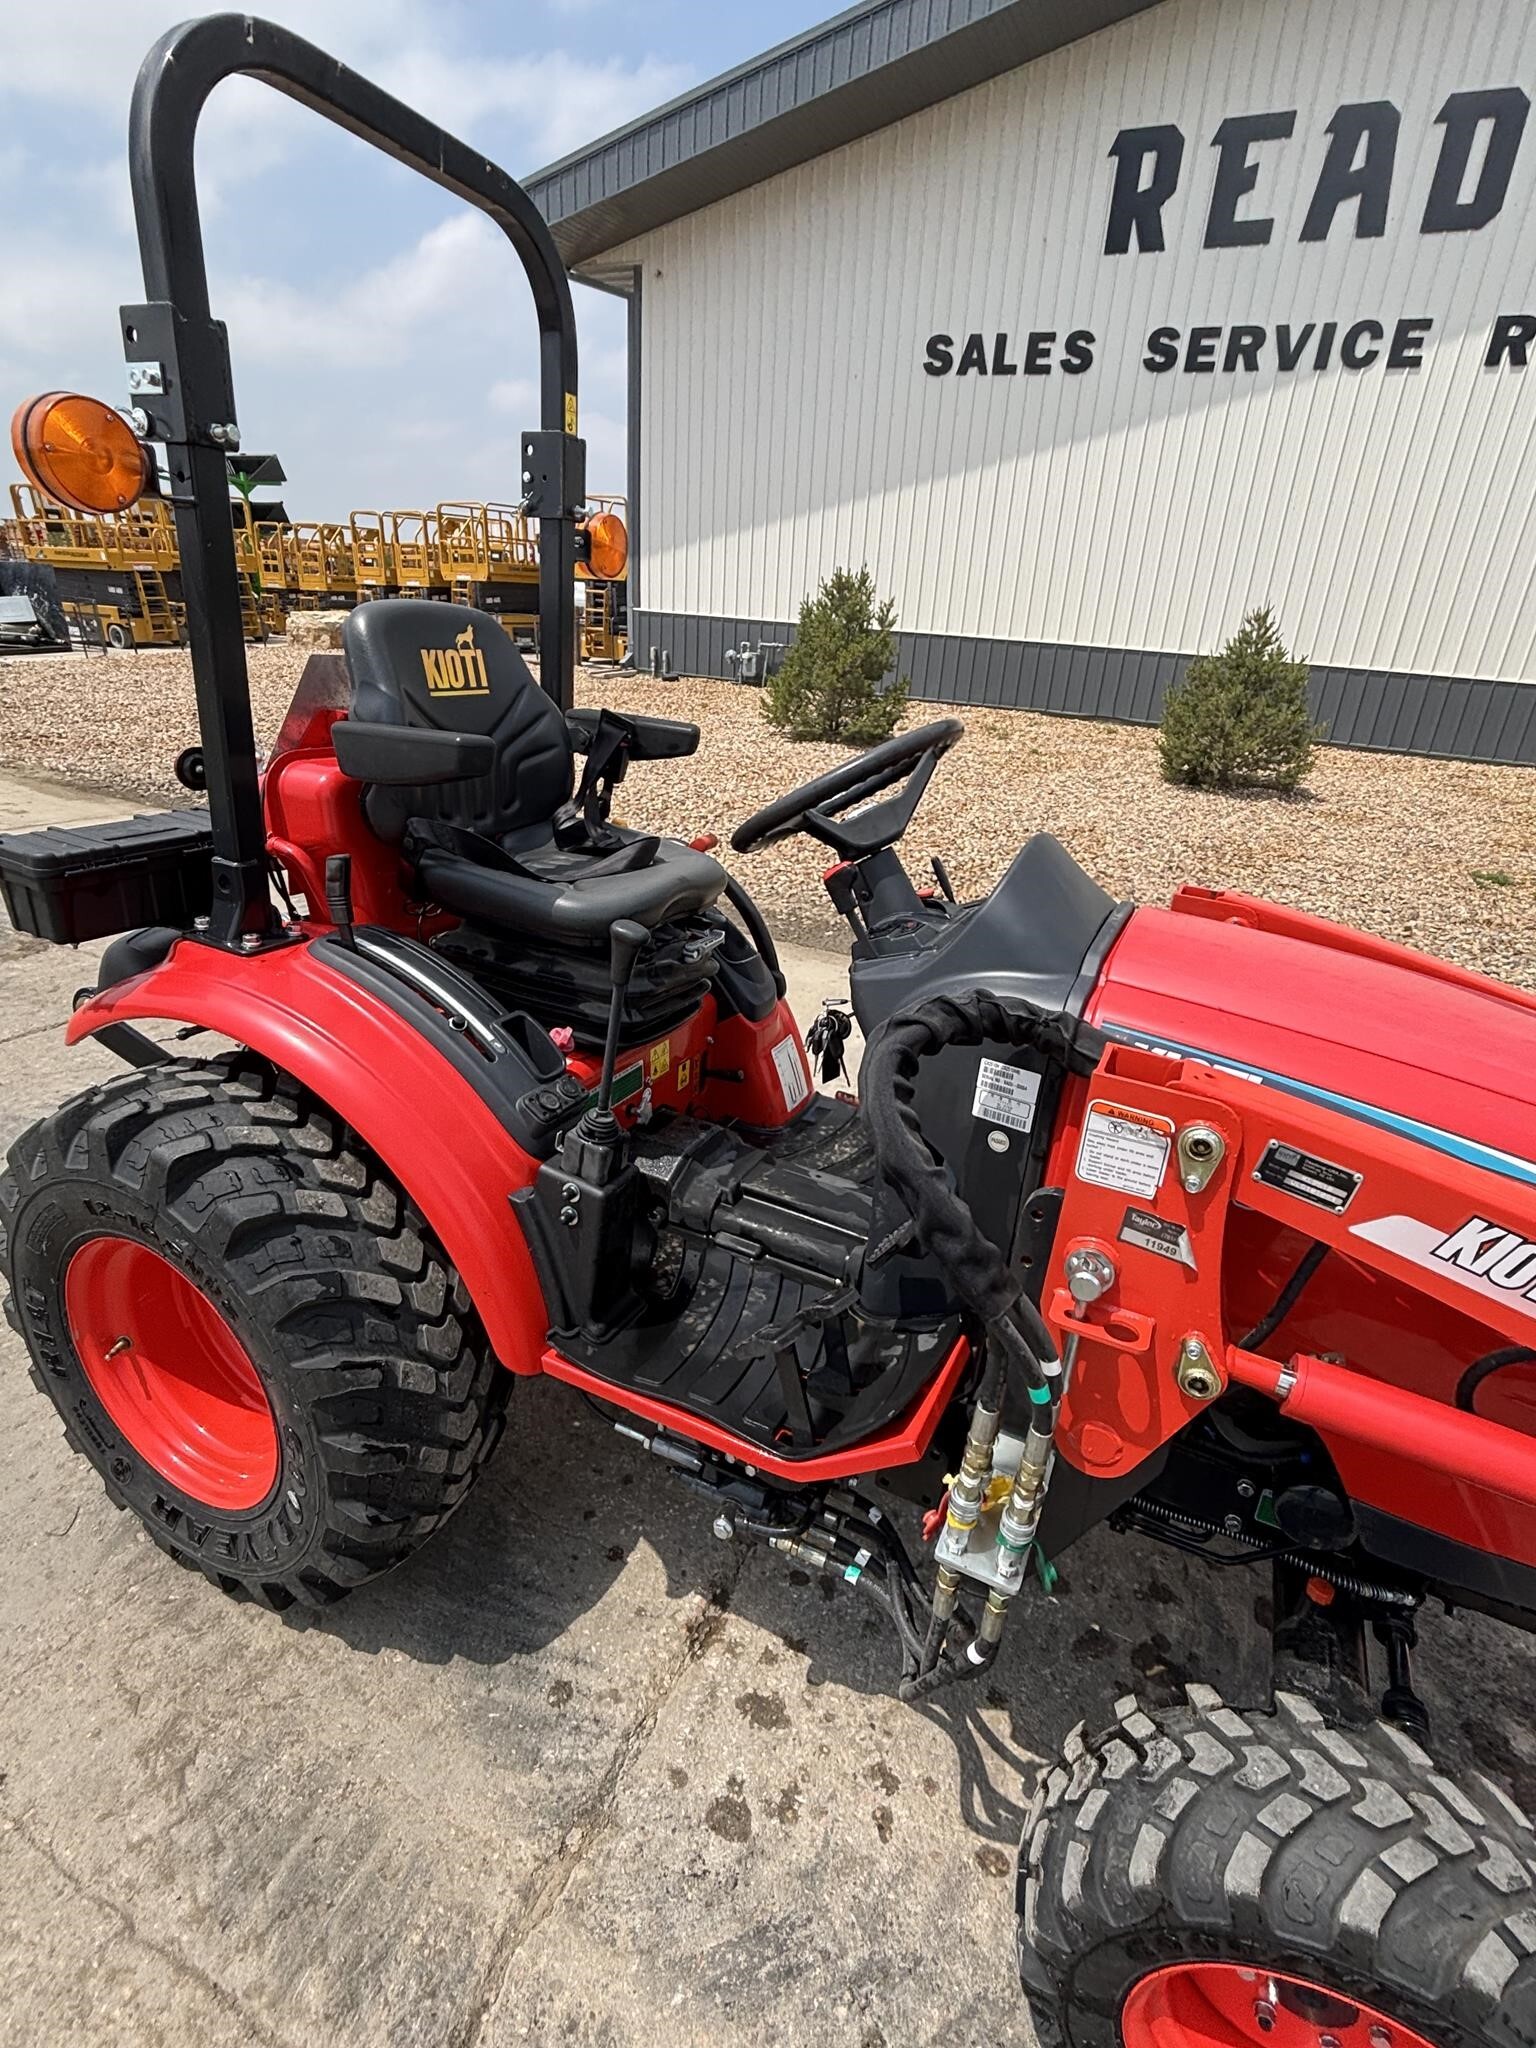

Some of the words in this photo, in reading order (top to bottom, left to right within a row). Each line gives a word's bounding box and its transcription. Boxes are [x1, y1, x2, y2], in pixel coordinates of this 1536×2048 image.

[1104, 87, 1531, 254] READ
[922, 329, 1097, 376] SALES
[1142, 318, 1434, 374] SERVICE
[420, 648, 489, 689] KIOTI
[1117, 1110, 1155, 1126] WARNING
[1130, 1212, 1158, 1229] Taylor
[1145, 1238, 1177, 1256] 11949
[1430, 1215, 1536, 1304] KIO
